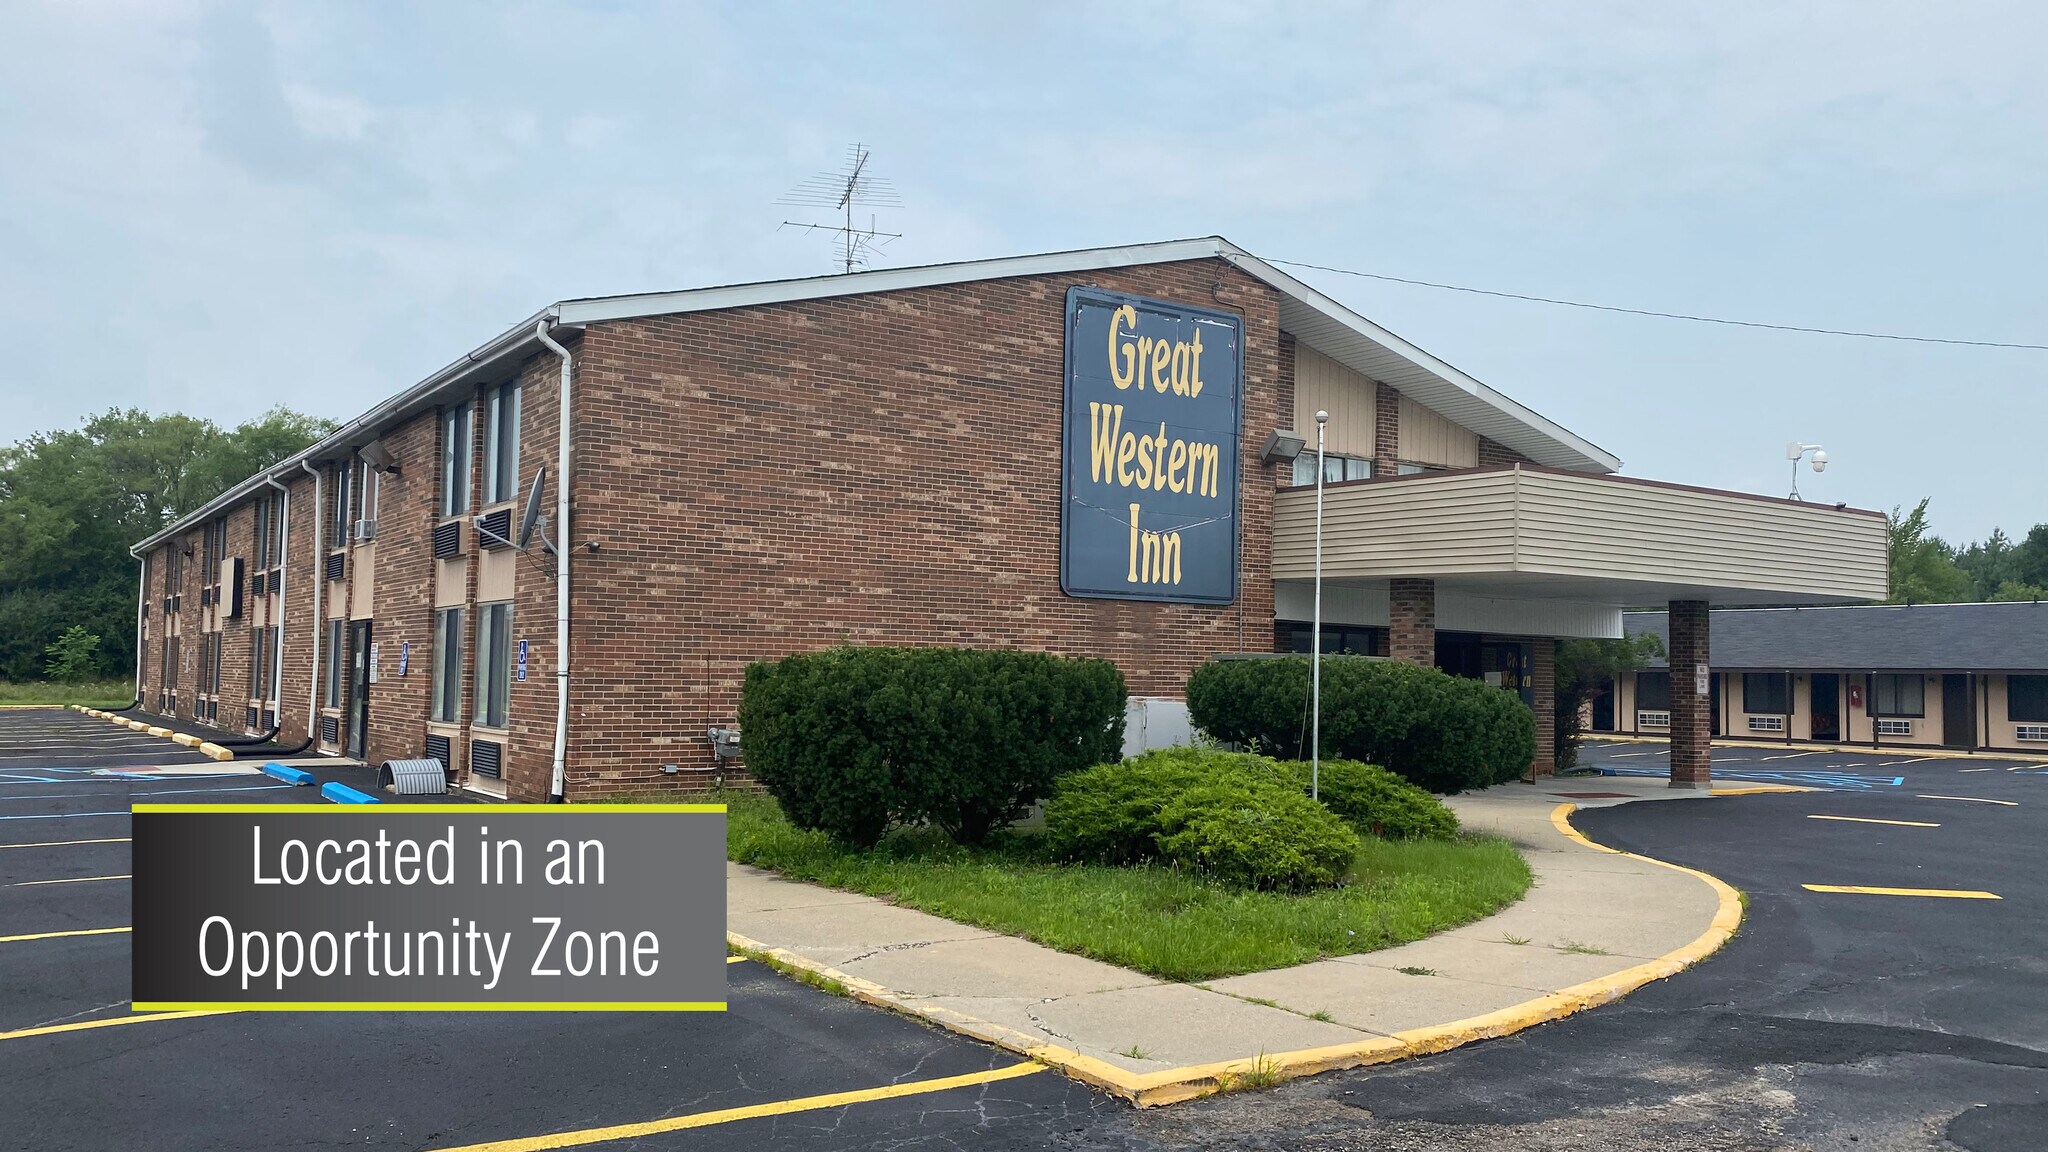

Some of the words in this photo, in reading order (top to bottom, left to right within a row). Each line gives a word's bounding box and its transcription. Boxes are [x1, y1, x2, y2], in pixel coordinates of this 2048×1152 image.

[1108, 304, 1204, 398] Great
[1089, 401, 1219, 498] Western
[1127, 503, 1182, 585] Inn
